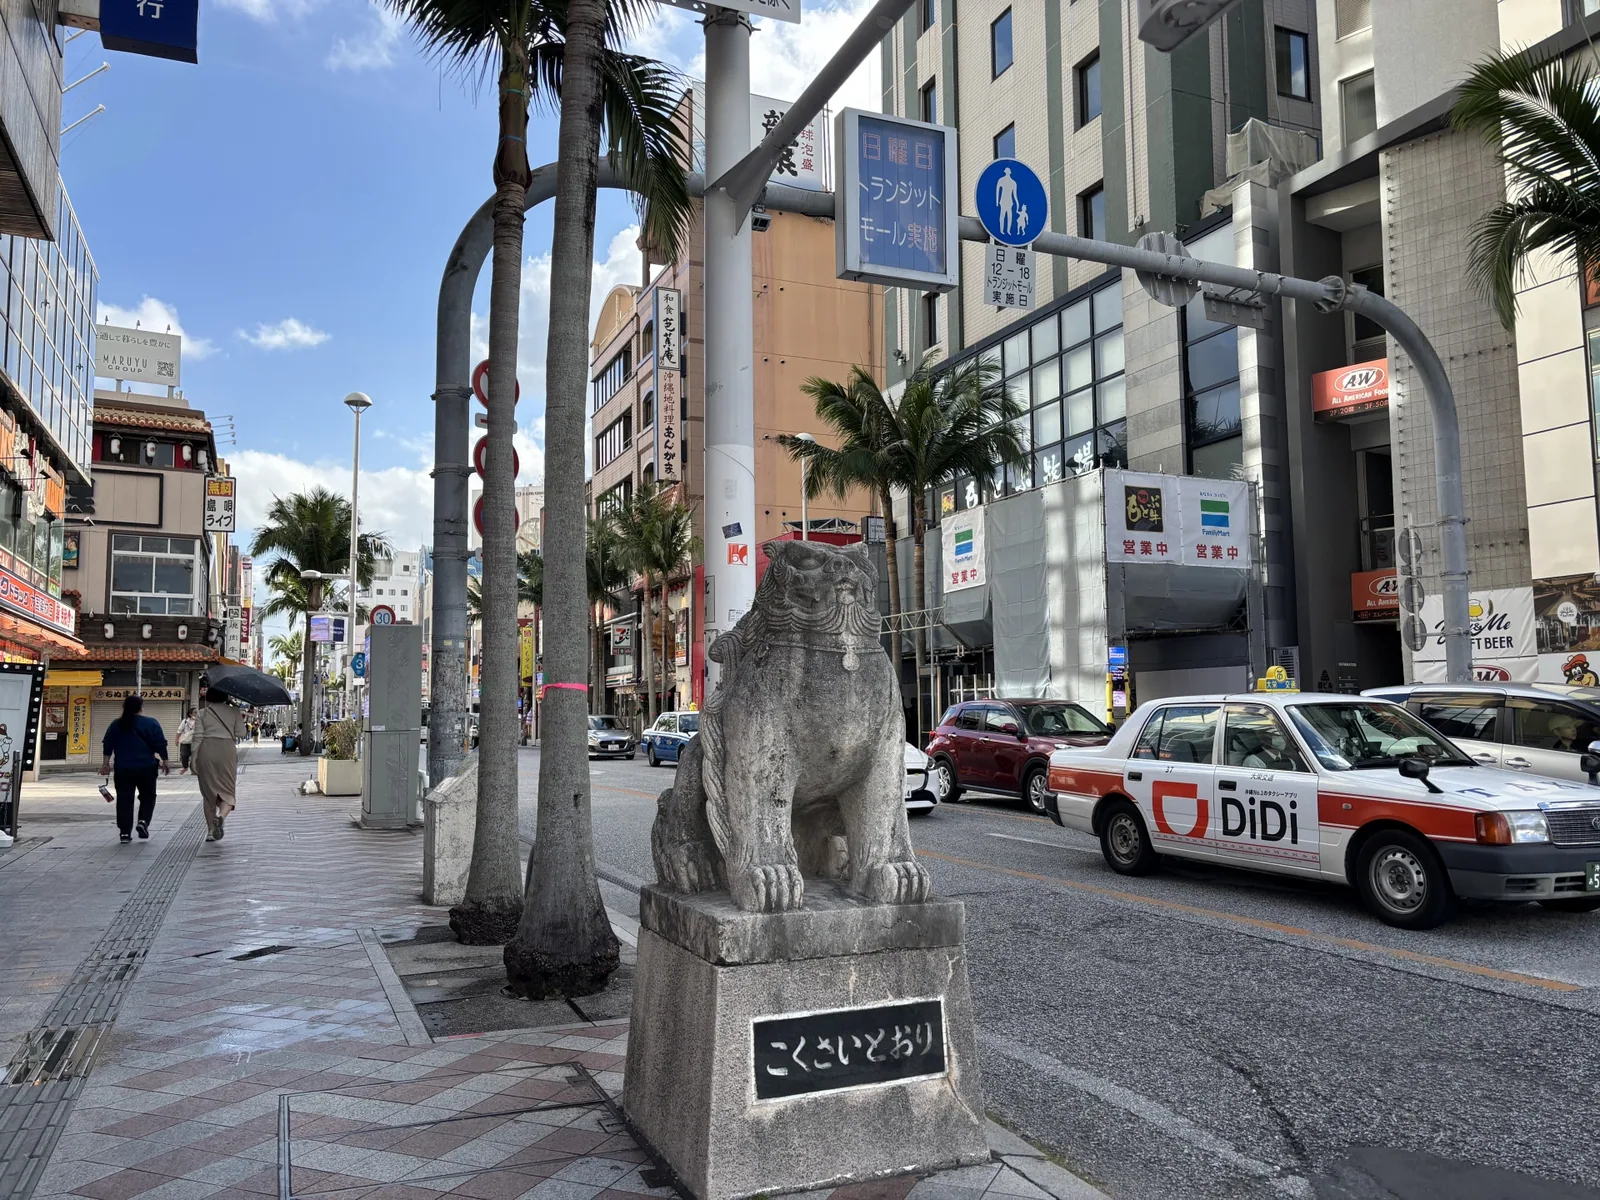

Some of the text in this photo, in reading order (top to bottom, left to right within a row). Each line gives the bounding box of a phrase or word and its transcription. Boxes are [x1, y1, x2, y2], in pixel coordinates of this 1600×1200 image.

[136, 0, 164, 19] 行
[800, 121, 815, 172] 球泡盛
[862, 132, 933, 170] 日曜日
[860, 217, 938, 253] モール実施
[996, 248, 1026, 266] 日曜
[987, 275, 1033, 294] トランジットモール
[992, 290, 1028, 307] 実施日
[96, 330, 171, 349] 通して暮らしを豊かに
[102, 353, 149, 369] MARUYU
[107, 364, 143, 373] GROUP
[1331, 395, 1342, 405] ALL
[1343, 391, 1373, 403] AMERICAN
[208, 480, 232, 496] 無料
[205, 513, 233, 528] ライブ
[1202, 528, 1230, 537] FamilyMart
[1122, 539, 1168, 556] 営業中
[1195, 543, 1238, 560] 営業中
[951, 567, 978, 585] 営業中
[1366, 597, 1399, 607] ALL AMERIC
[375, 612, 391, 625] 30
[1484, 635, 1514, 650] BEER
[1221, 796, 1298, 845] DiDi
[766, 1021, 933, 1077] こくさいとおり
